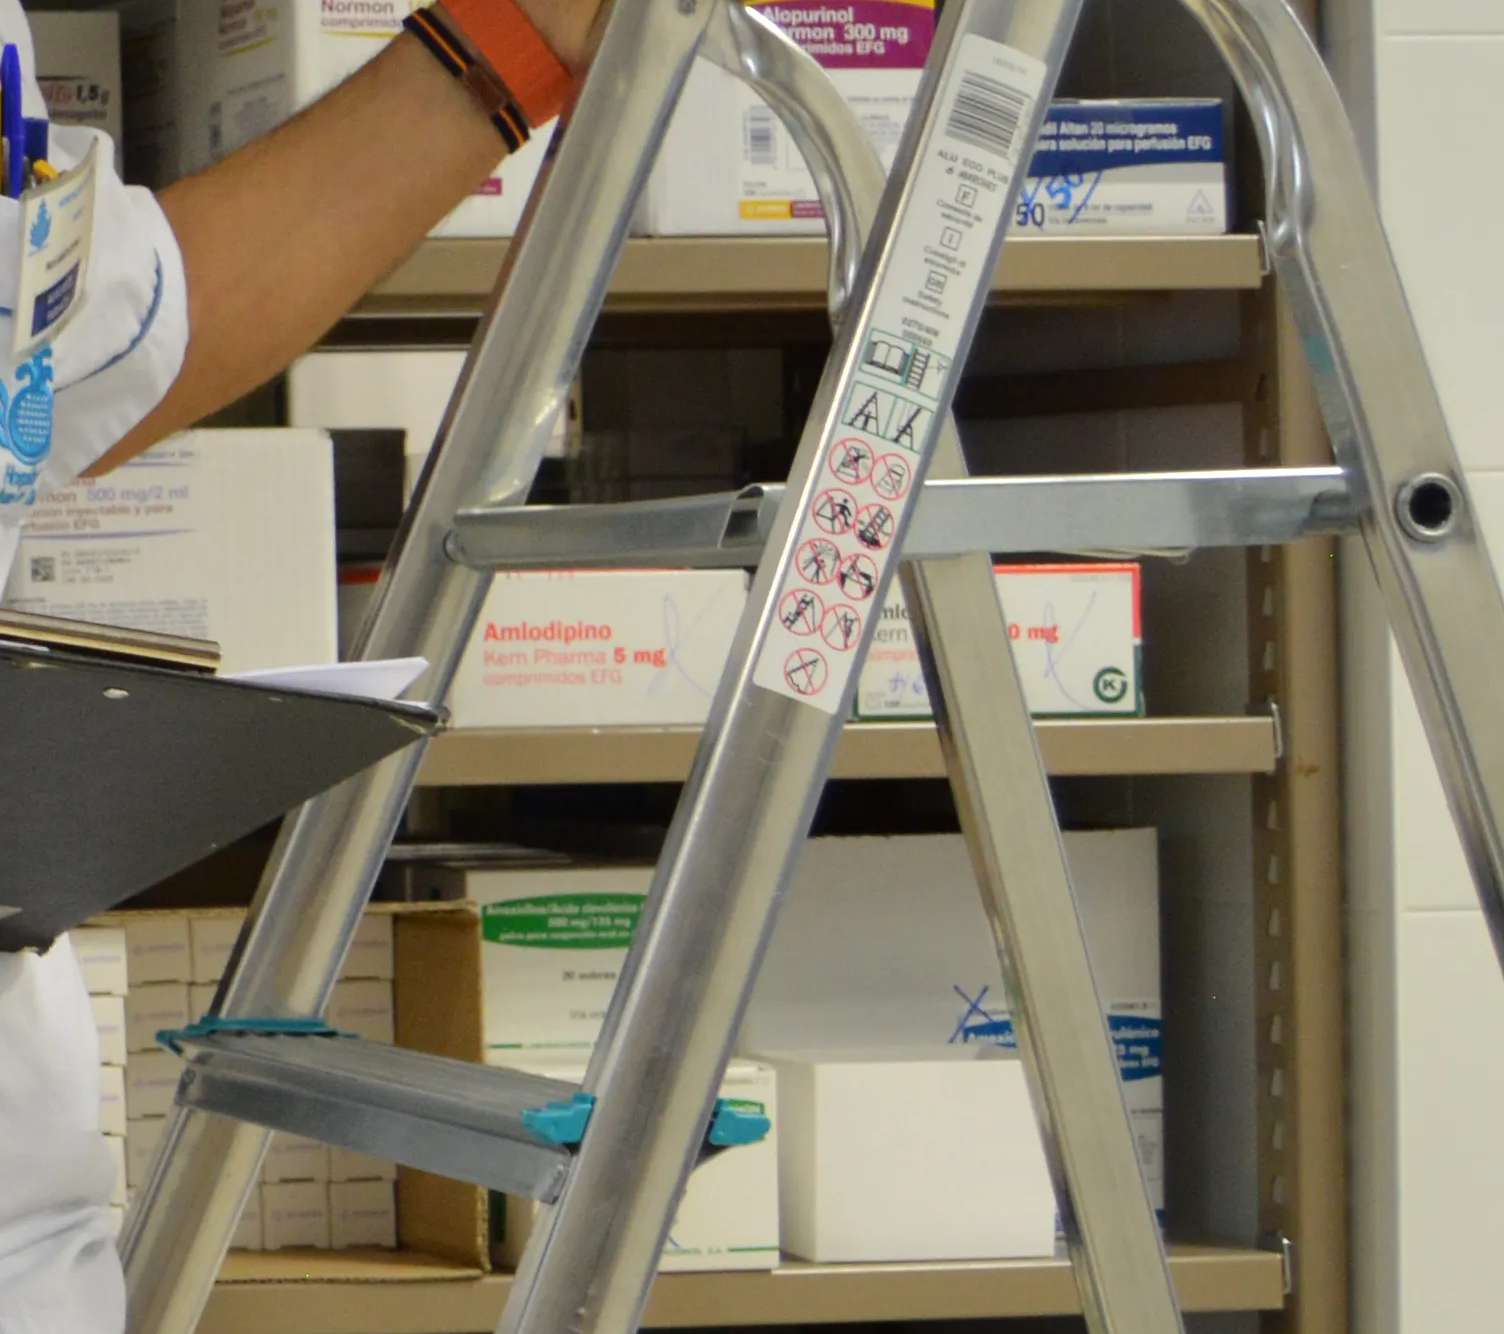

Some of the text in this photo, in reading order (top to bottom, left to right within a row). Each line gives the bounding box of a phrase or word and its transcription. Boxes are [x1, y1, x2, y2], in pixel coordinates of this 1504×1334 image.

[763, 6, 853, 29] Alopurinol
[844, 24, 909, 45] 300 mg
[857, 41, 887, 55] EFG
[1106, 122, 1178, 138] microgramos
[1187, 136, 1212, 151] EFG
[483, 621, 612, 645] Amlodipino
[1027, 625, 1060, 644] mg
[483, 647, 667, 668] Kern Pharma 5 mg
[483, 670, 623, 688] comprimidos EFG
